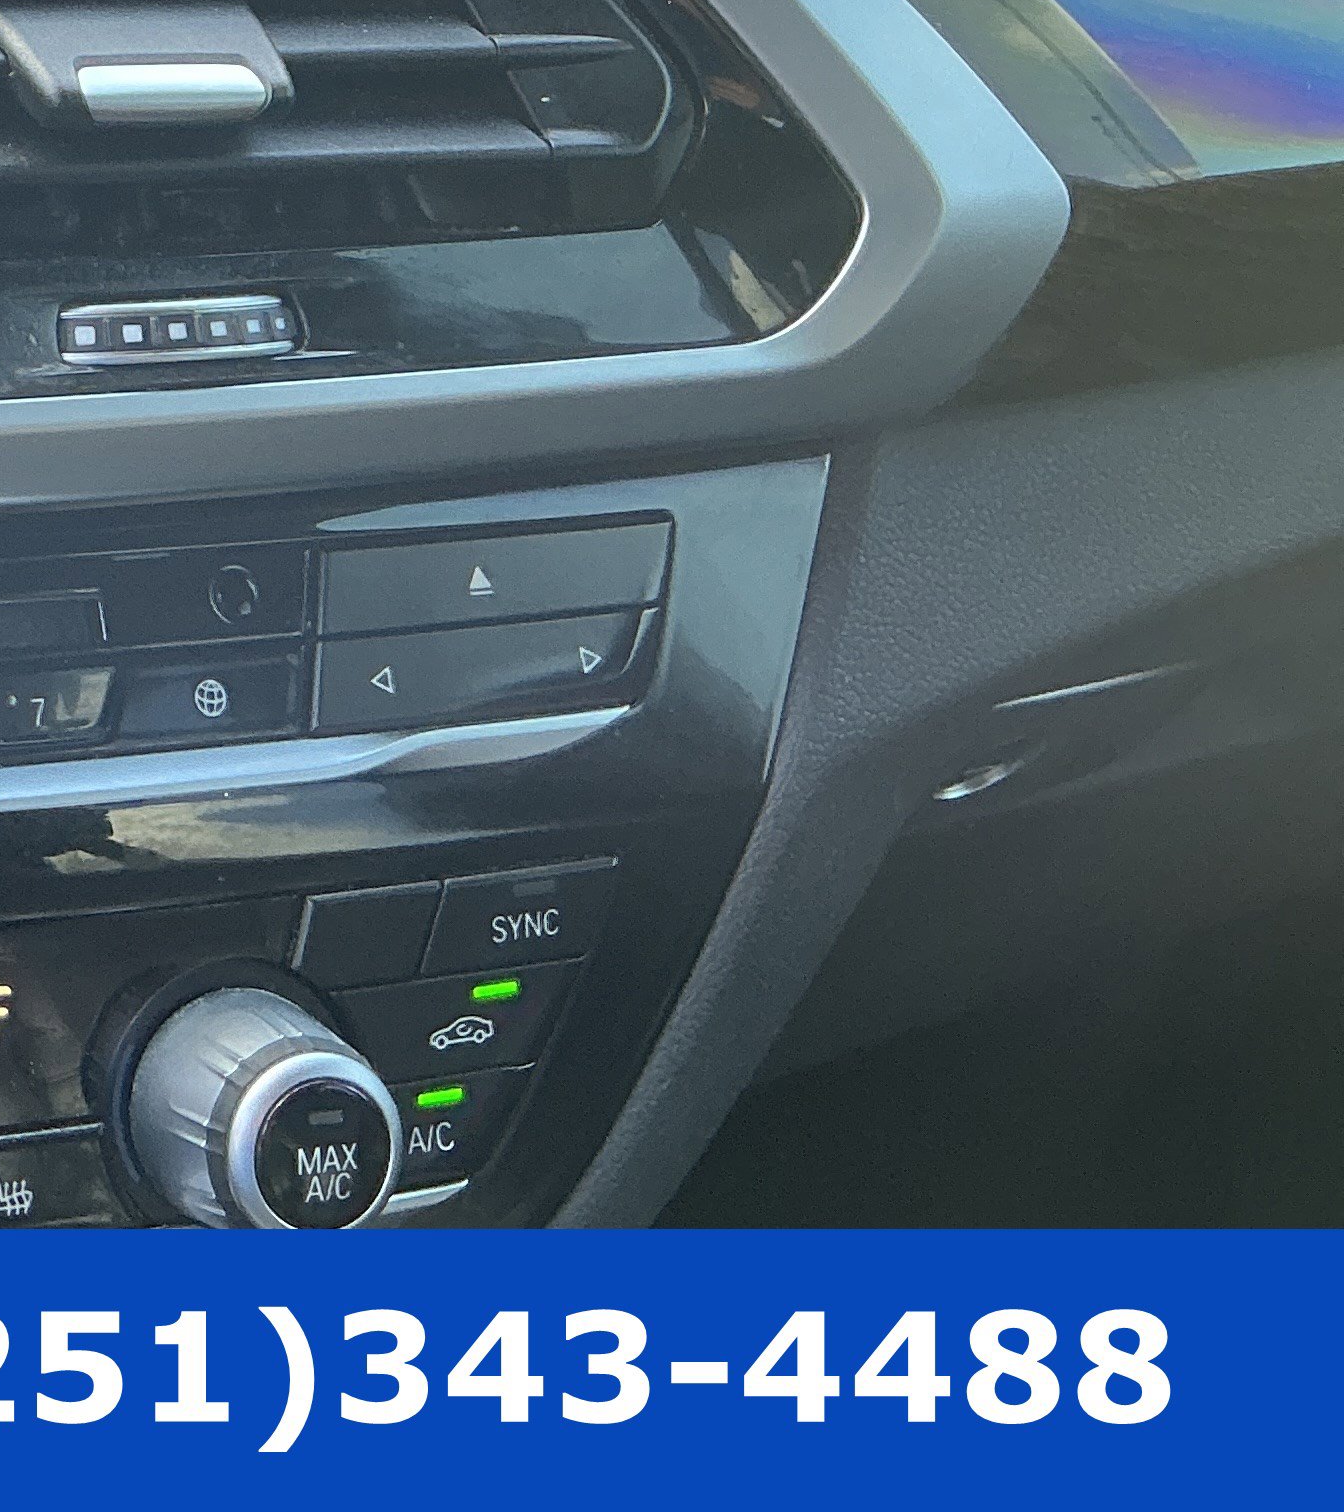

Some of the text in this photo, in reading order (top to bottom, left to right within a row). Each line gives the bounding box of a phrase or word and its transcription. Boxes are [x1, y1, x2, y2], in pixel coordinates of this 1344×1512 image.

[30, 698, 46, 727] 7
[491, 908, 560, 943] SYNC
[408, 1121, 455, 1154] A/C
[297, 1143, 358, 1174] MAX
[306, 1172, 352, 1203] A/C
